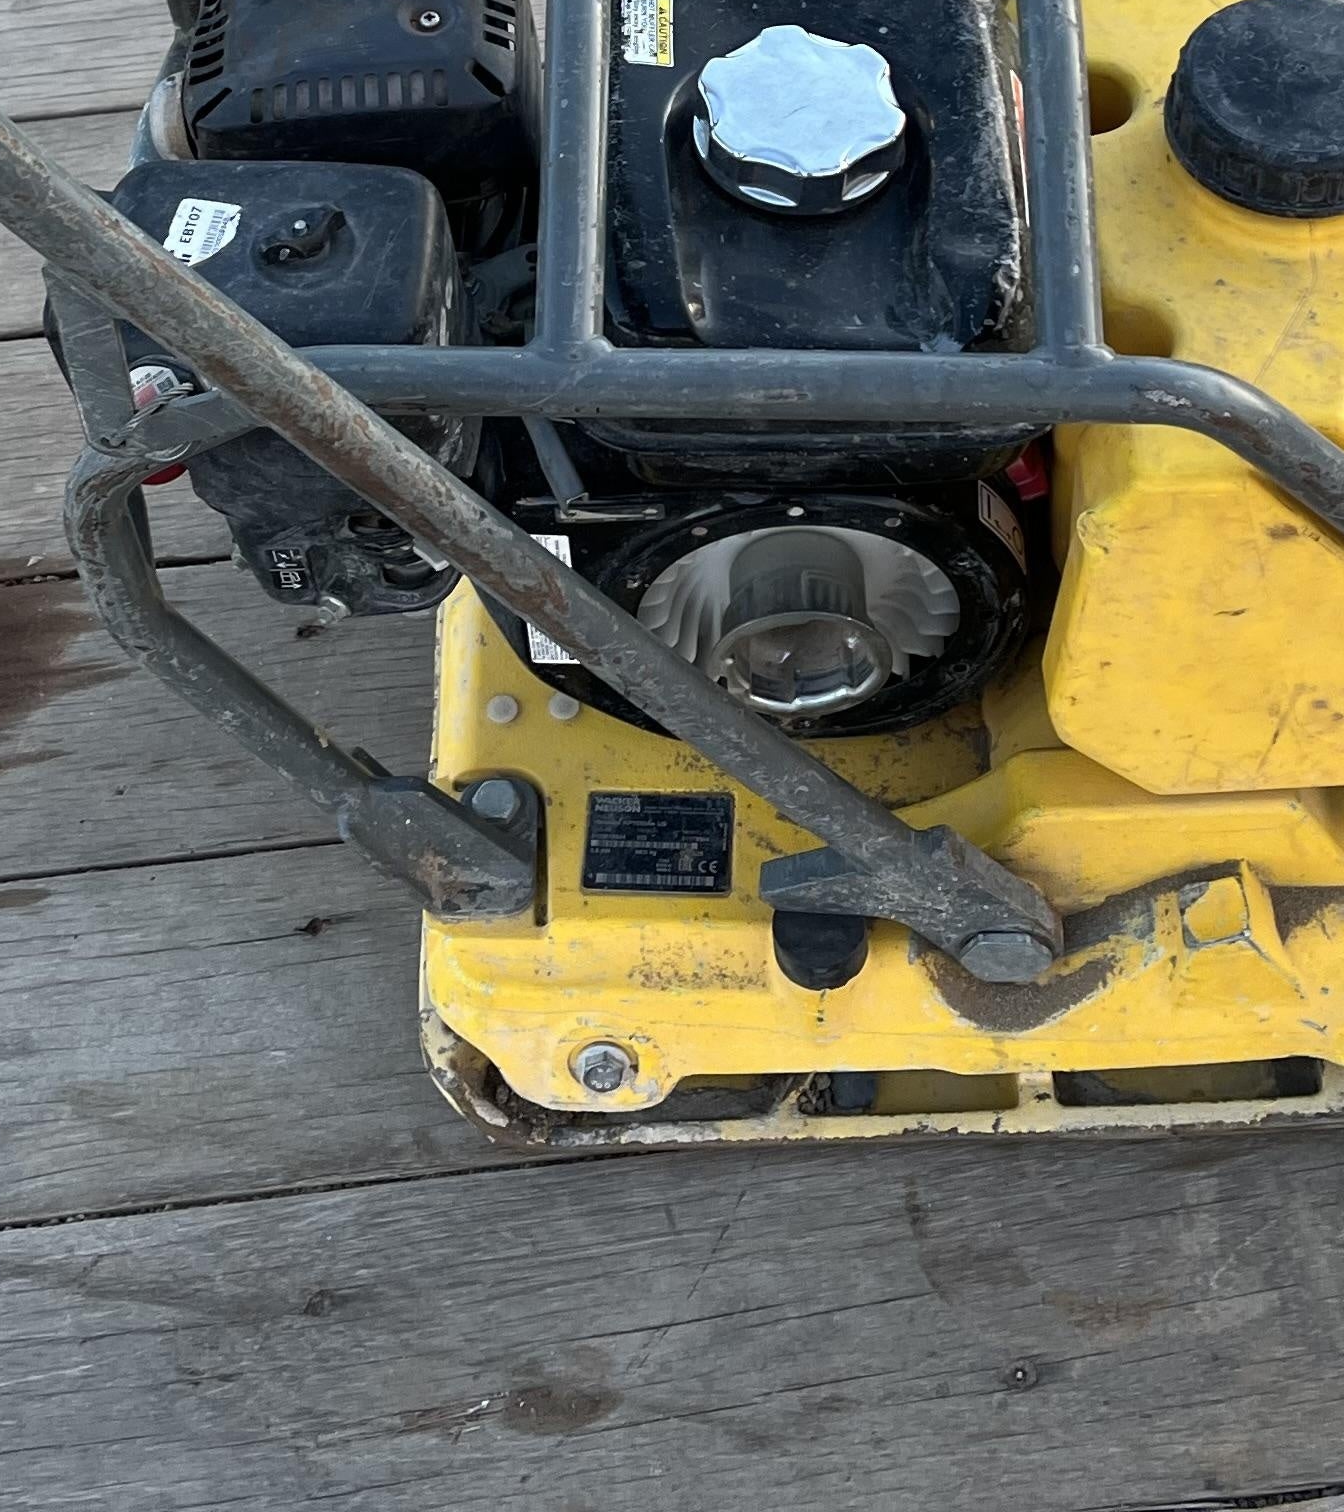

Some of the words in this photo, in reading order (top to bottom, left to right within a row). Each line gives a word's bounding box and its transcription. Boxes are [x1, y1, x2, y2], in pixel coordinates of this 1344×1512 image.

[658, 16, 668, 55] CAUTION
[179, 206, 203, 245] EBT07
[594, 804, 641, 813] NEUSON
